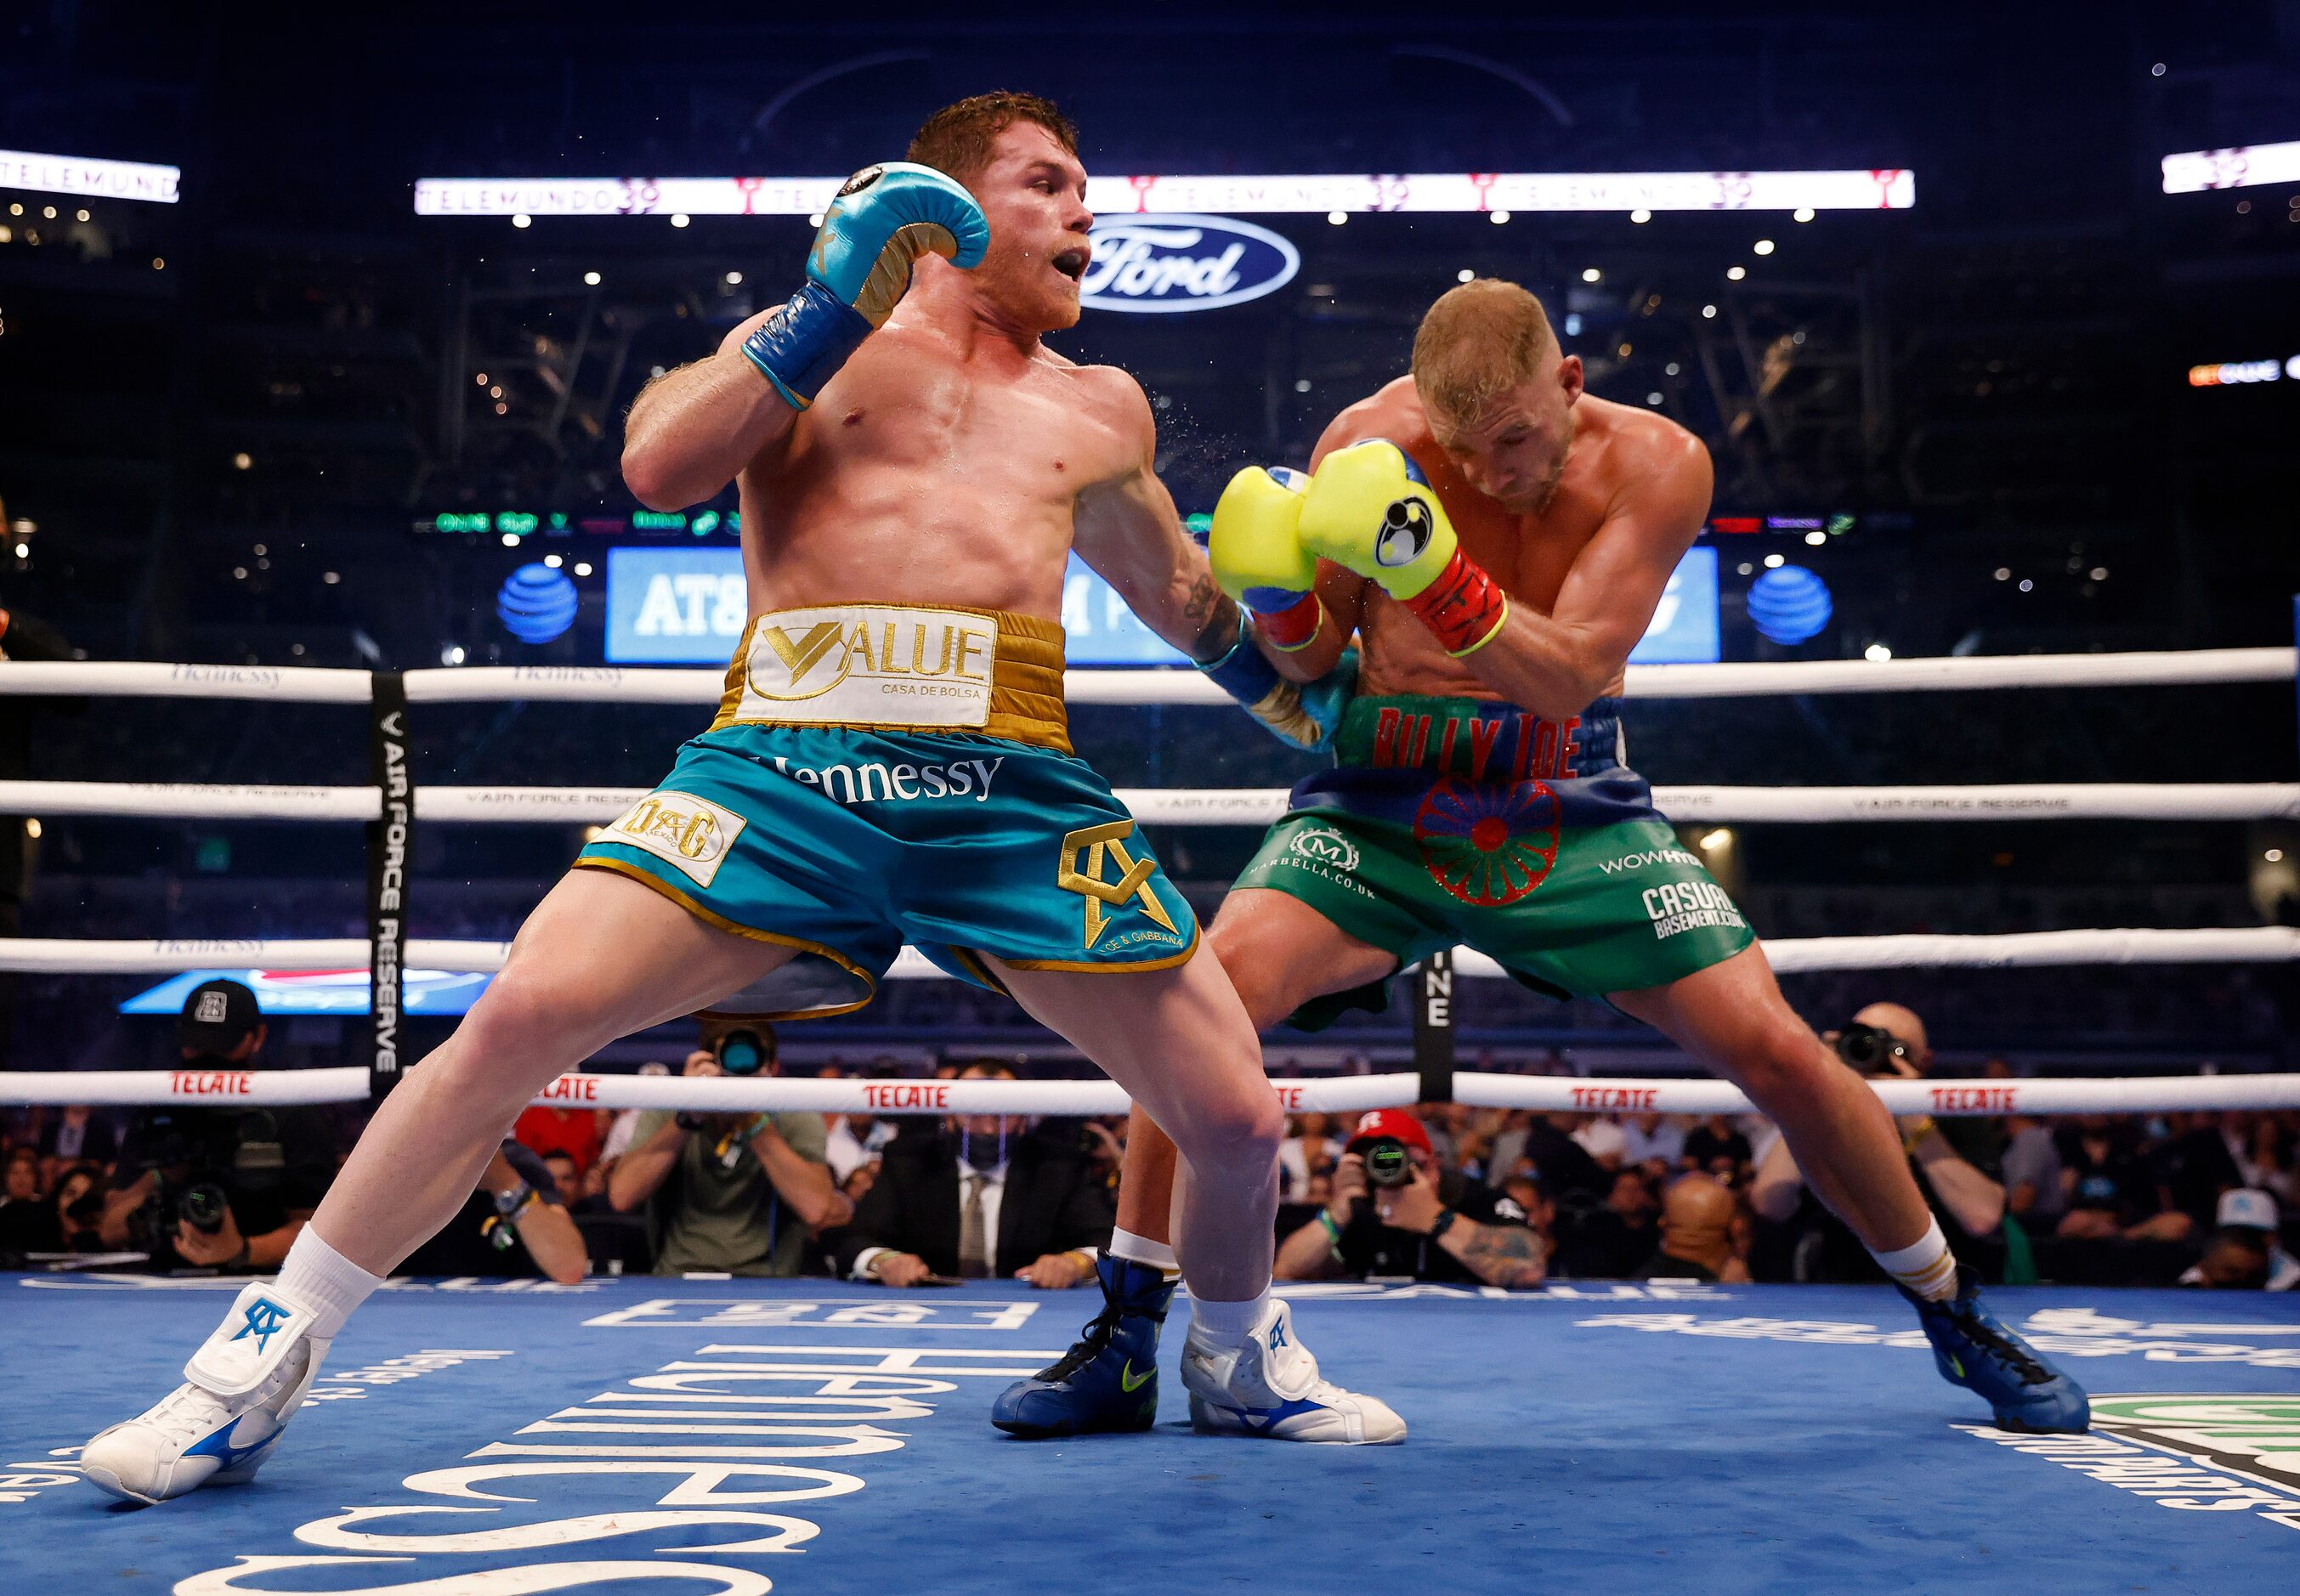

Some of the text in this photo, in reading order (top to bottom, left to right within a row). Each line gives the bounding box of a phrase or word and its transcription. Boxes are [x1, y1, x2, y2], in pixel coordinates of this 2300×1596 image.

[1084, 228, 1246, 297] Ford
[882, 683, 981, 699] CASA DE BOLSA
[749, 756, 1005, 804] ennessy
[376, 740, 408, 1073] AIR FORCE RESERVE
[1131, 931, 1184, 948] GABBANA
[169, 1070, 252, 1095] TECATE
[863, 1085, 950, 1108] TECATE
[1571, 1088, 1662, 1109] TECATE
[1929, 1088, 2019, 1111] TECATE
